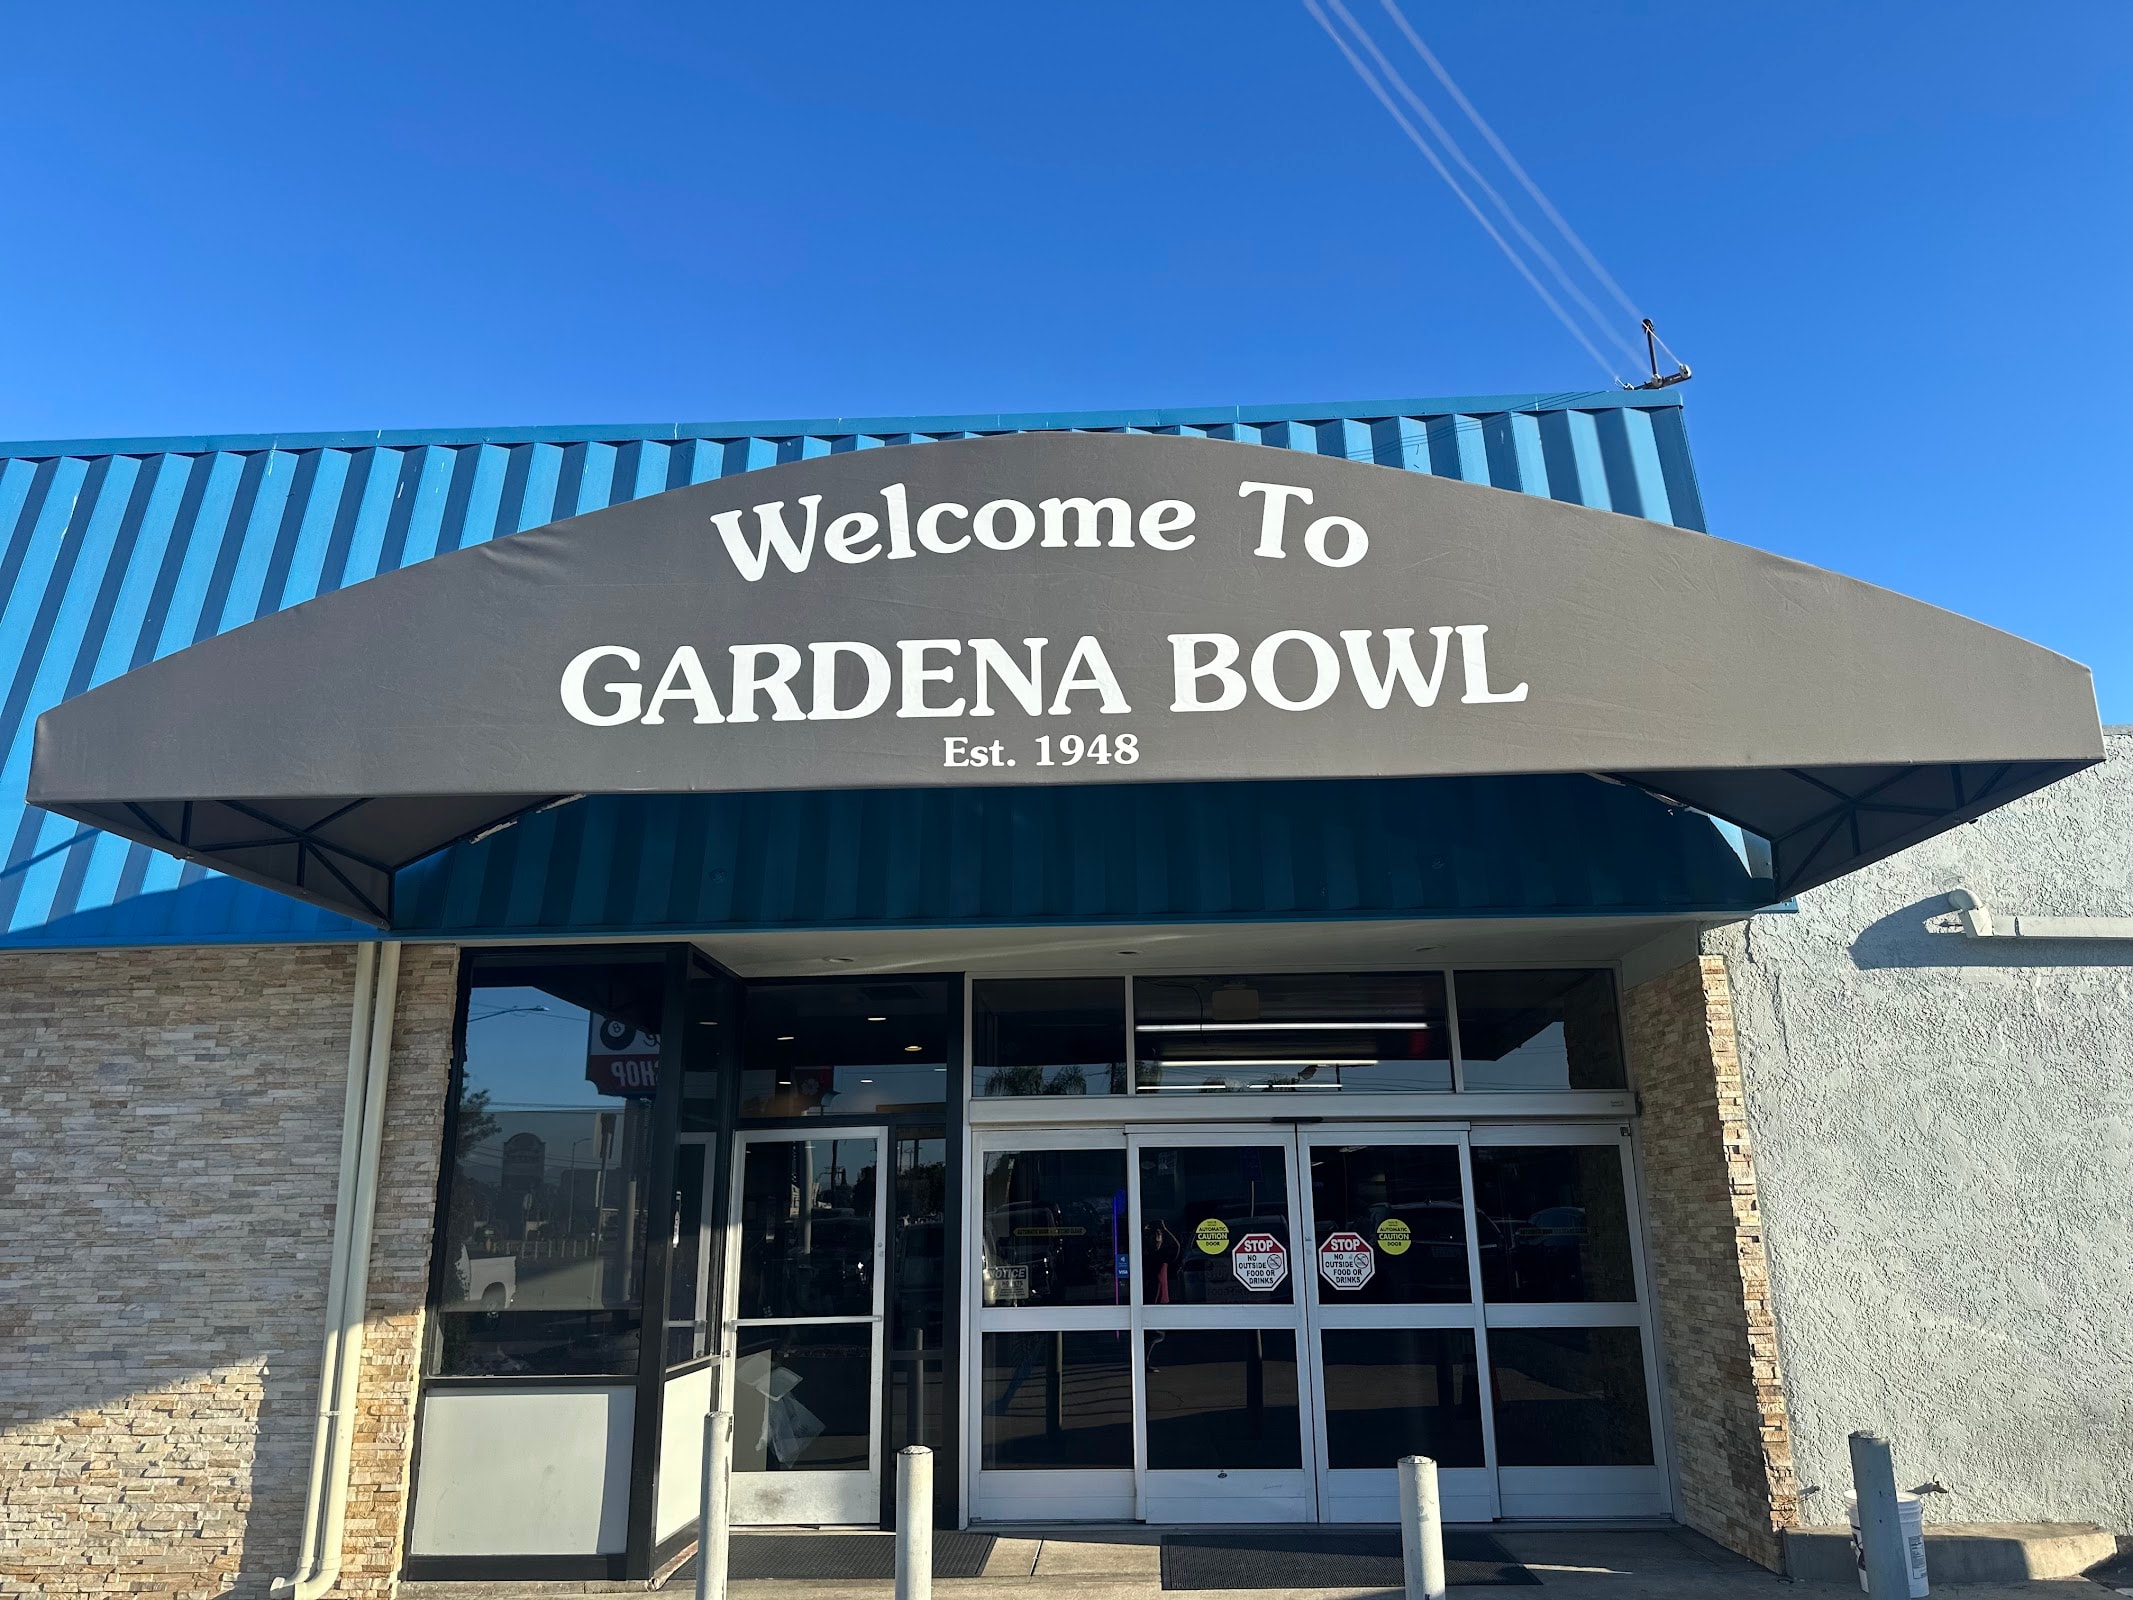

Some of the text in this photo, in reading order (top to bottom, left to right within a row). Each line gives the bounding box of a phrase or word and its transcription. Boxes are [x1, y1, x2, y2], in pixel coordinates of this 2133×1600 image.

[710, 480, 1369, 582] Welcome To
[560, 624, 1530, 728] GARDENA BOWL
[943, 733, 1140, 768] Est. 1948
[1244, 1240, 1274, 1252] STOP
[1330, 1239, 1361, 1251] STOP
[989, 1268, 1026, 1279] NOTICE
